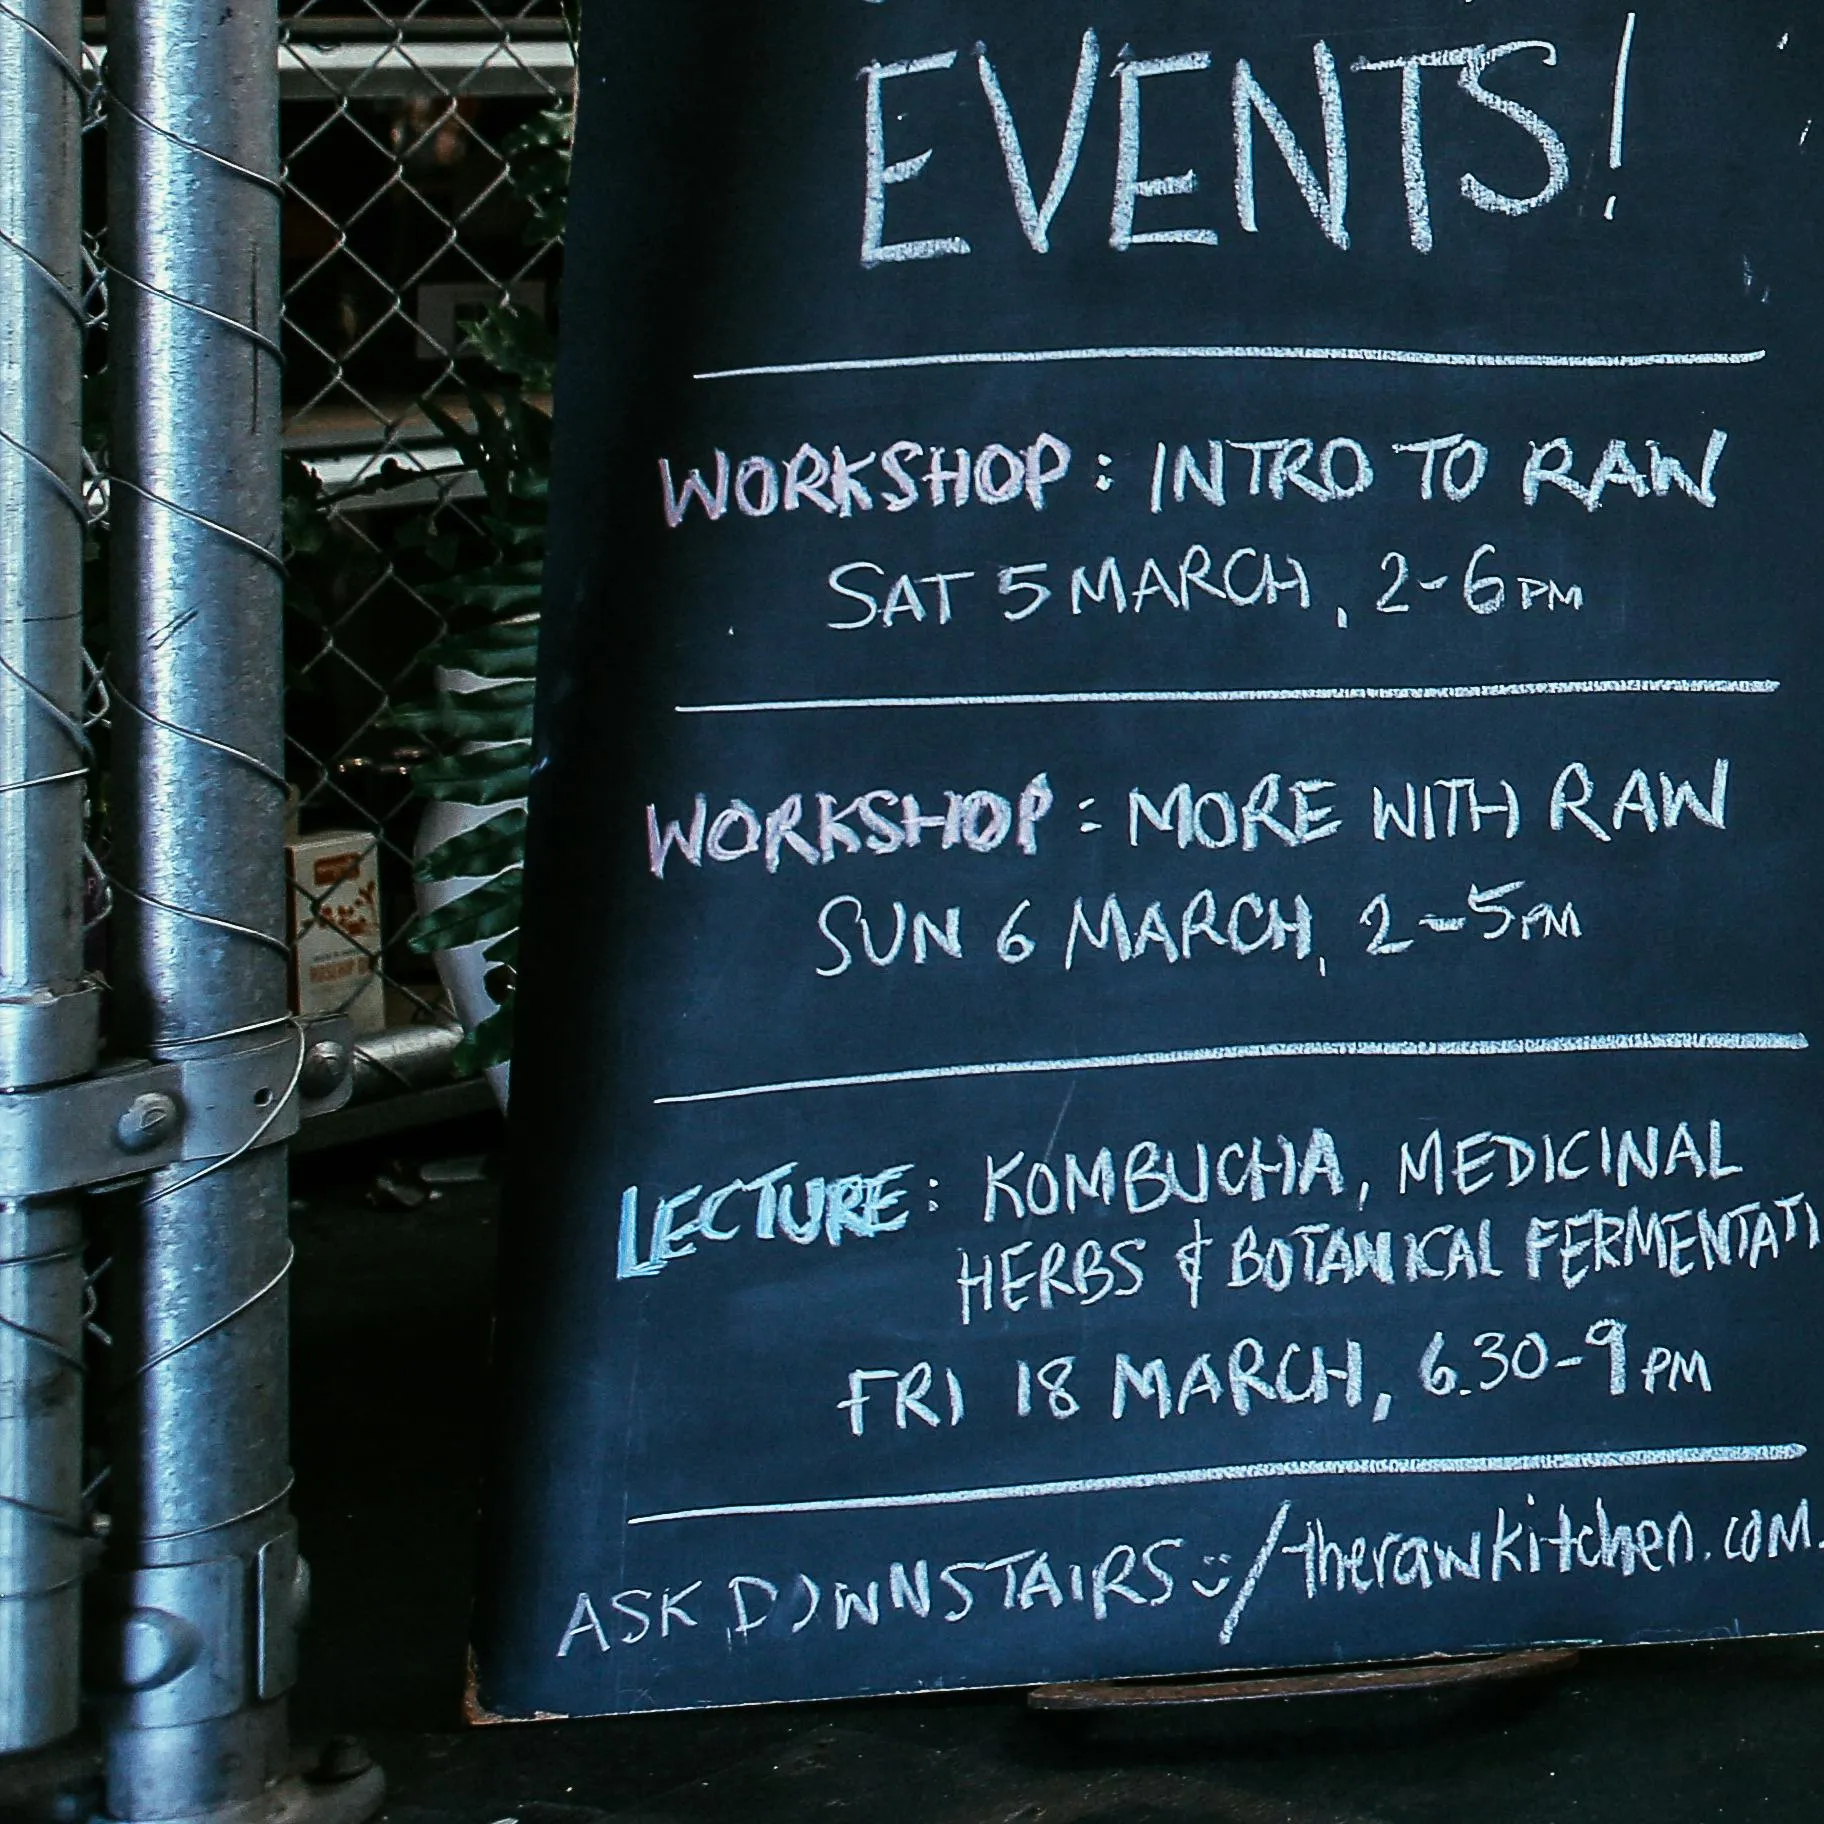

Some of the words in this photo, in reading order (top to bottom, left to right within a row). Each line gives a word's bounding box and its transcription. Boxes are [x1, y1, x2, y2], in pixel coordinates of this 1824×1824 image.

[859, 12, 1637, 269] EVENTS!
[1149, 436, 1375, 514] INTRO
[1391, 432, 1489, 504] TO
[1521, 428, 1729, 514] RAW
[826, 560, 976, 630] SAT
[997, 560, 1053, 623] 5
[1127, 771, 1344, 853] MORE
[1372, 776, 1521, 843] WITH
[1548, 757, 1730, 843] RAW
[814, 894, 964, 978] SUN
[995, 898, 1037, 965] 6
[982, 1126, 1371, 1224] KOMBUCHA,
[1398, 1117, 1745, 1197] MEDICINAL
[955, 1237, 1148, 1326] HERBS
[1225, 1217, 1505, 1293] BOTANICAL
[836, 1360, 965, 1438] FRI
[1015, 1354, 1082, 1421] 18
[555, 1579, 704, 1658] ASK
